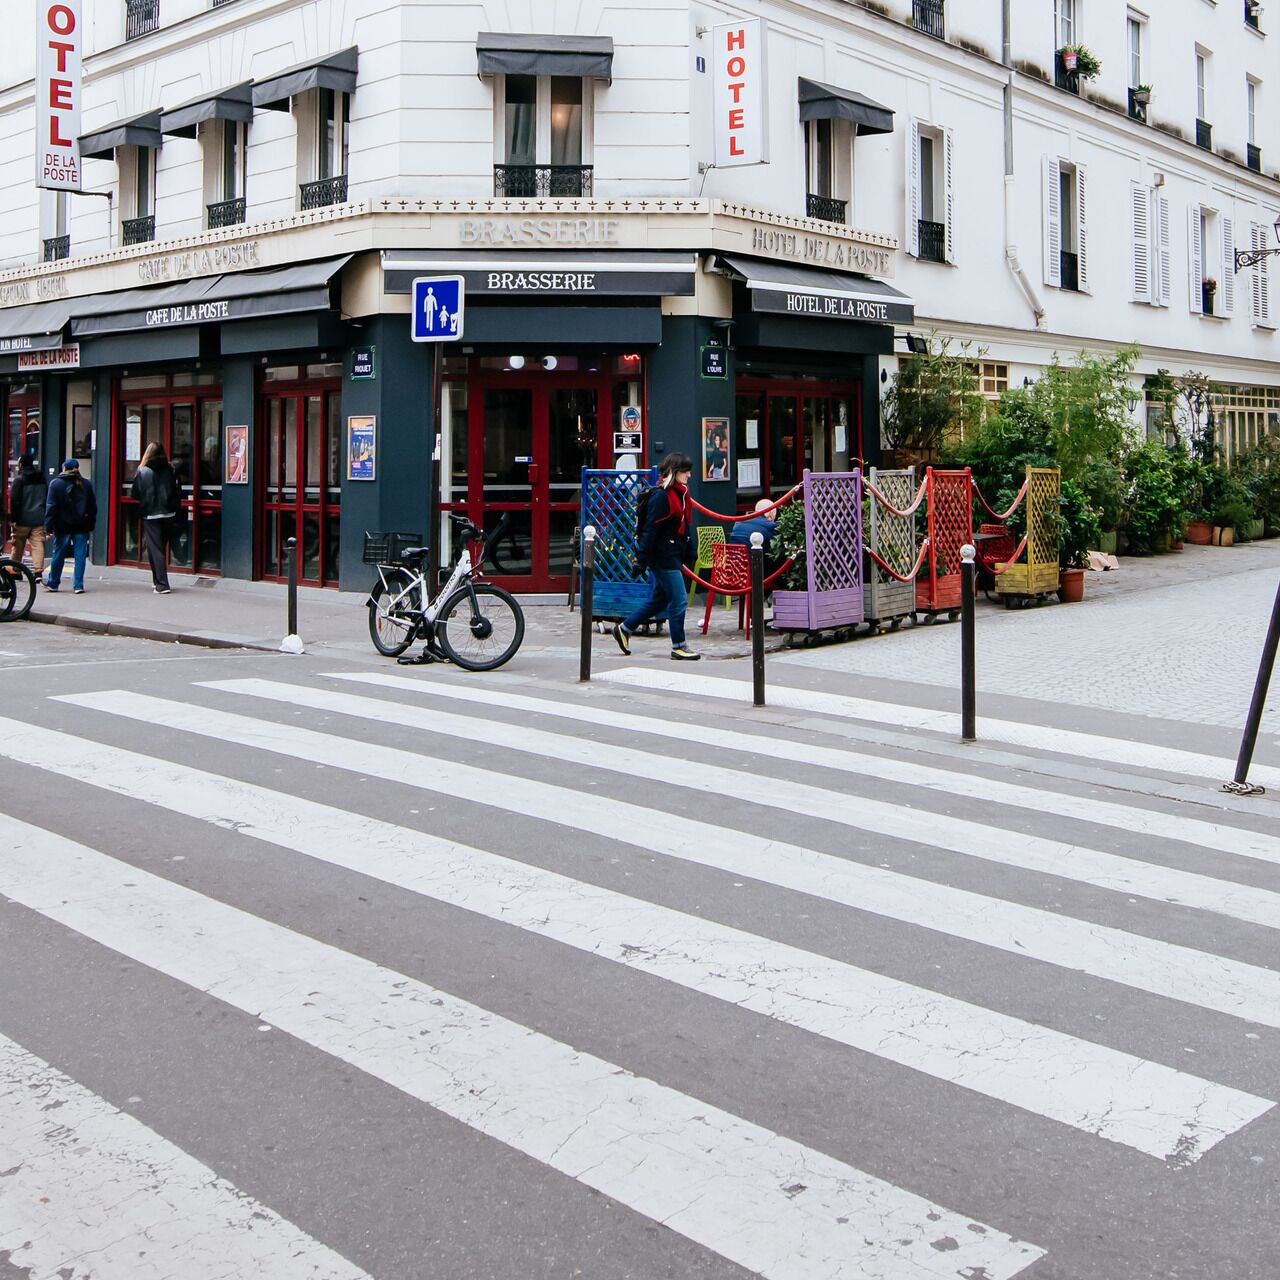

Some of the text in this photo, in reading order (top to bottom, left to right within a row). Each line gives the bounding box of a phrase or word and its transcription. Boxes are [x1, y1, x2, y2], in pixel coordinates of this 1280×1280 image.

[726, 29, 746, 156] HOTEL
[45, 153, 76, 168] DE LA
[43, 167, 78, 183] POSTE
[459, 219, 620, 244] BRASSERIE
[752, 227, 890, 272] HOTEL DE LA POSTE
[487, 272, 596, 291] BRASSERIE
[146, 301, 229, 325] CAFE DE LA POSTE
[786, 294, 888, 320] HOTEL DE LA POSTE
[40, 351, 48, 365] DE
[49, 350, 57, 365] LA
[59, 348, 78, 363] POSTE
[357, 353, 368, 361] RUE
[710, 353, 719, 361] RUE
